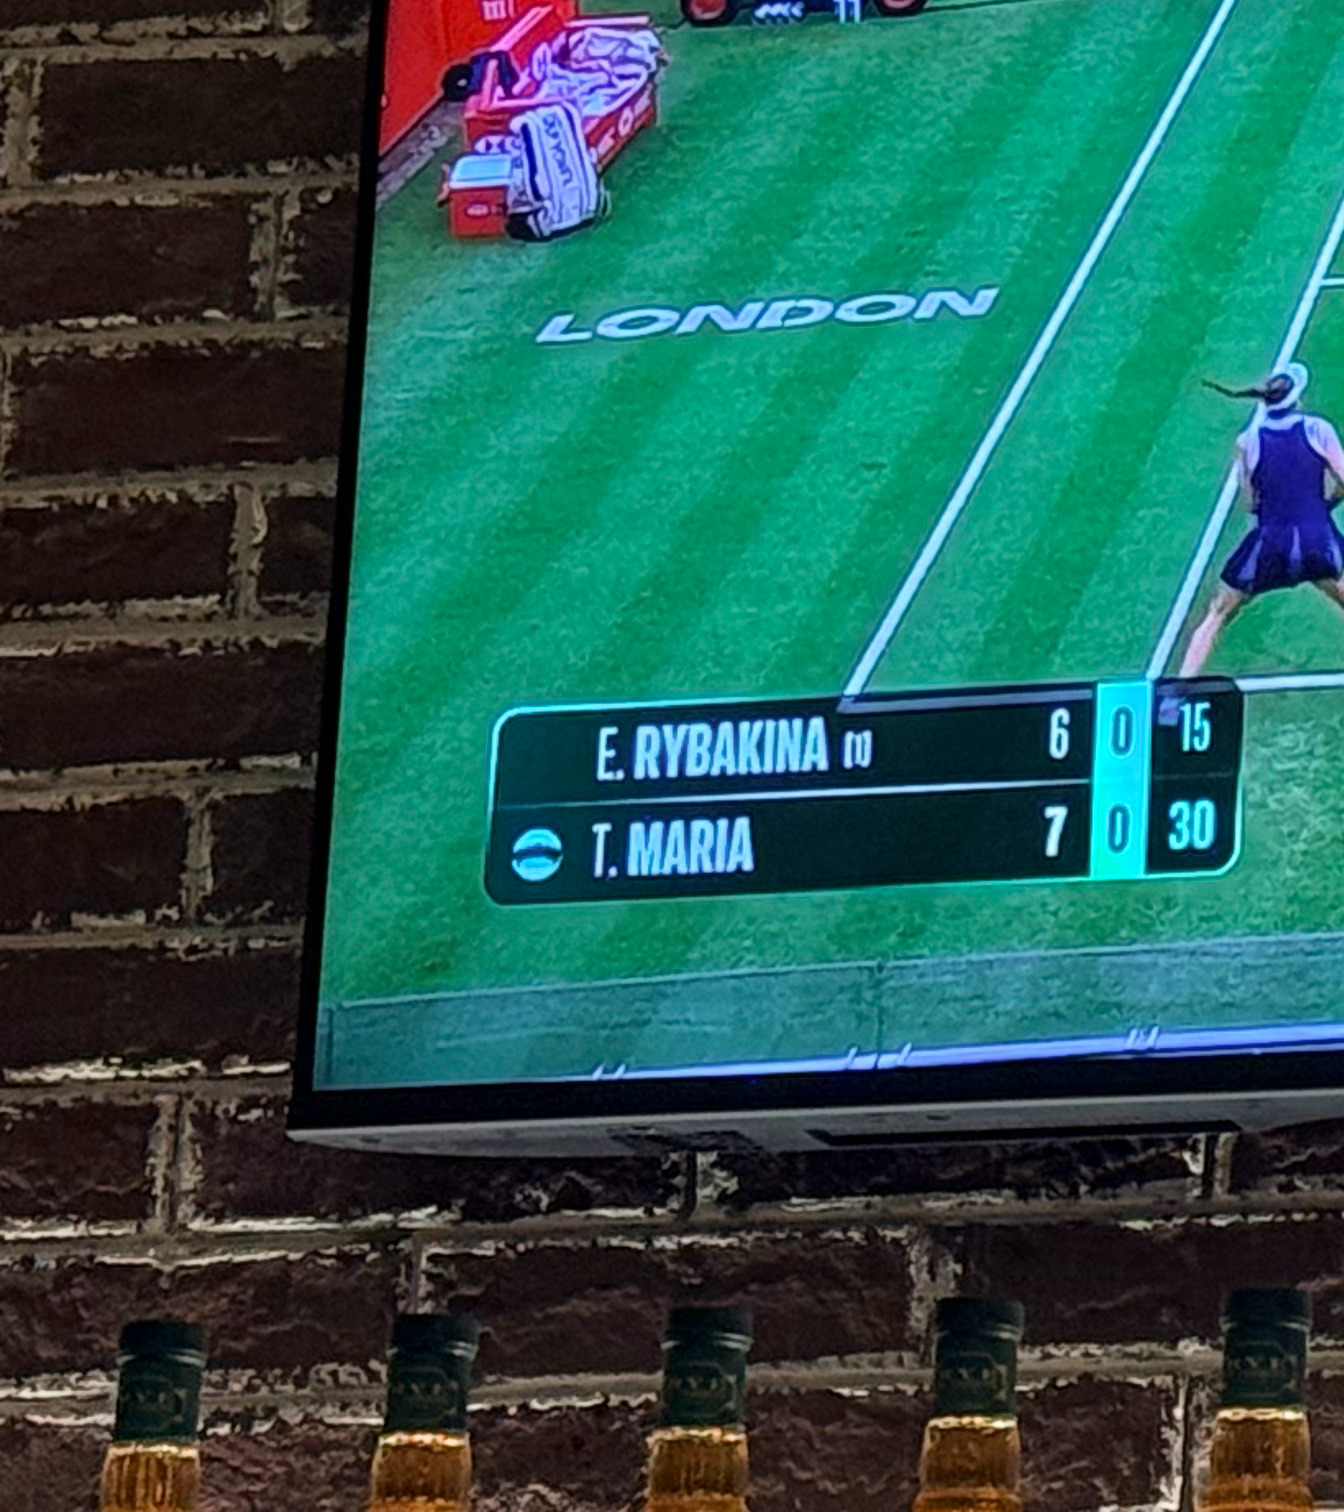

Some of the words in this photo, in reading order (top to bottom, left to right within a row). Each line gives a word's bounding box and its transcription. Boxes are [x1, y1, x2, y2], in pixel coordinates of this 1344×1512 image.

[536, 287, 1001, 344] LONDON
[596, 726, 626, 782] E.
[633, 717, 829, 780] RYBAKINA
[1049, 709, 1070, 759] 6
[1110, 706, 1133, 756] 0
[1180, 703, 1212, 753] 15
[592, 822, 618, 877] T.
[626, 816, 755, 876] MARIA
[1044, 805, 1068, 856] 7
[1106, 806, 1129, 854] 0
[1169, 799, 1216, 851] 30
